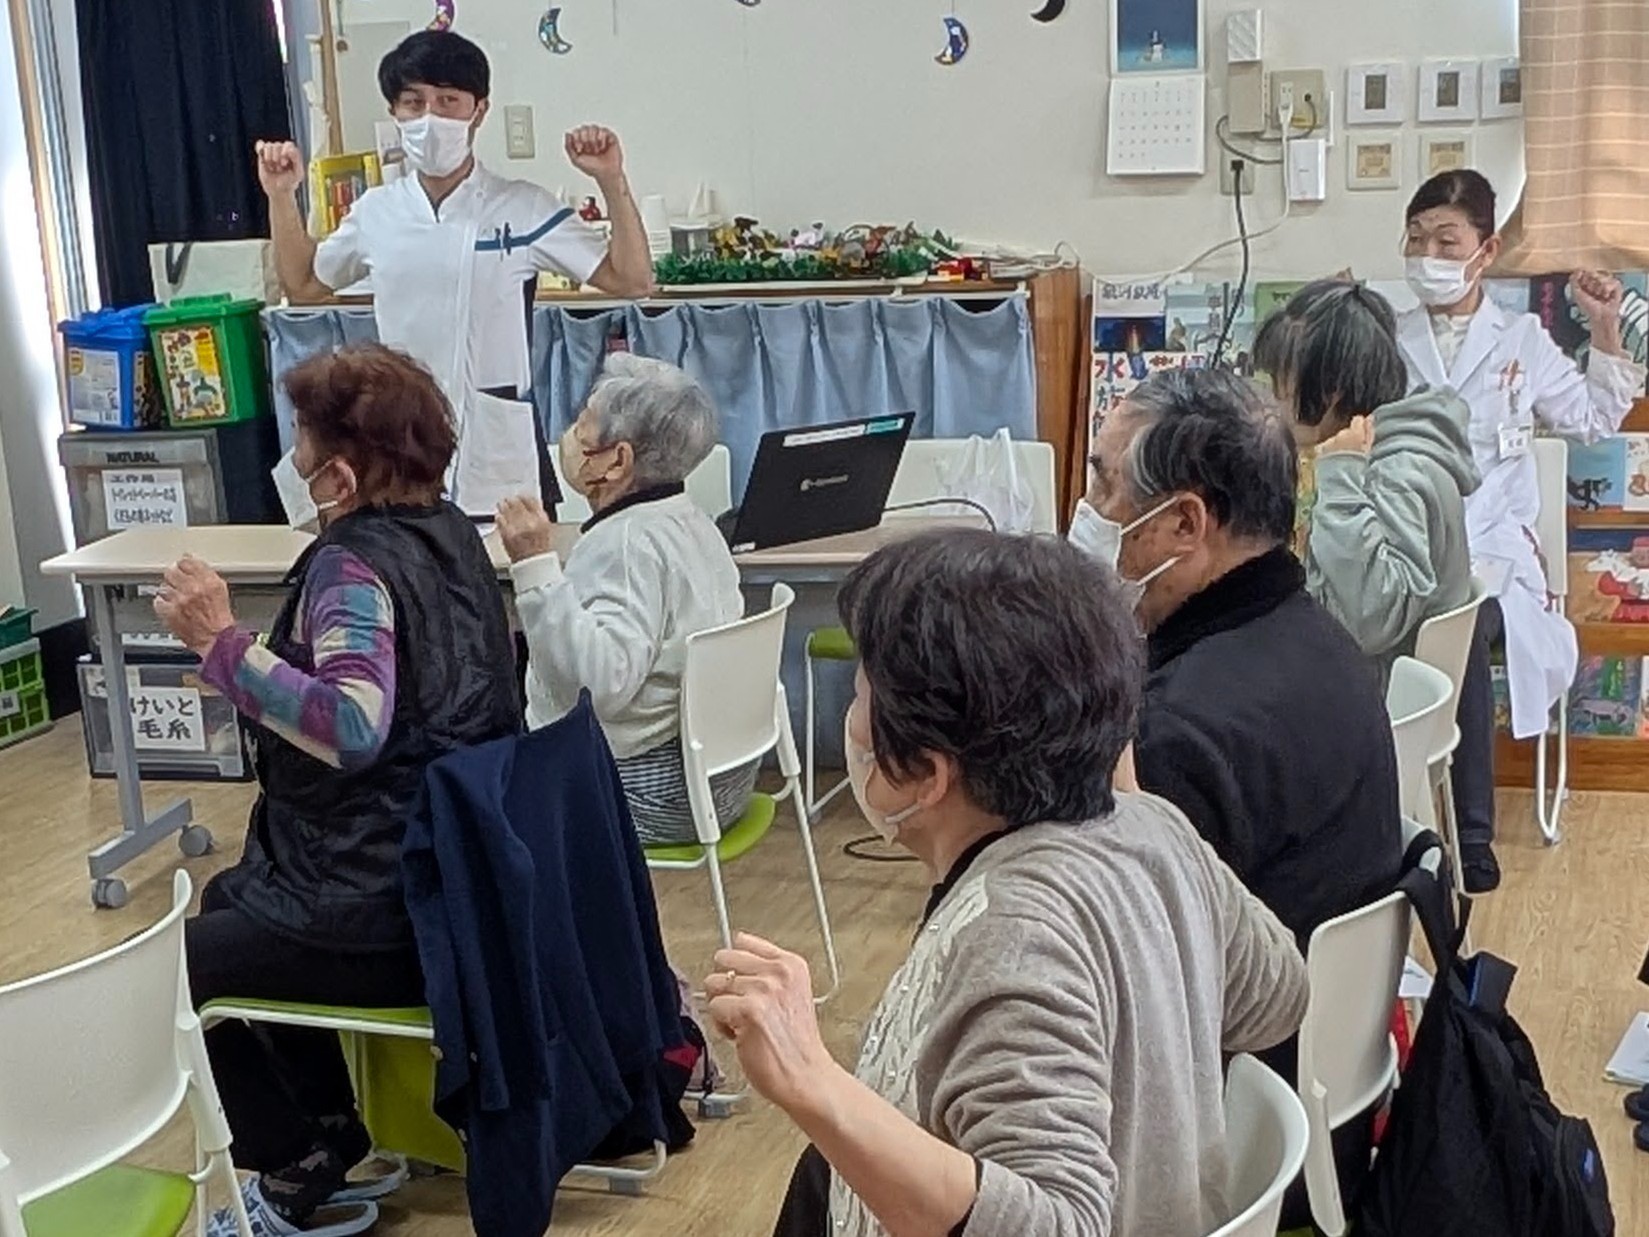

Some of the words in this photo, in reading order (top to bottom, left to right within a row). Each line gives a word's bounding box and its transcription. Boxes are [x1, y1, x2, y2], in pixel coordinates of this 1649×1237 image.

[106, 450, 160, 464] NATURAL
[130, 696, 195, 717] けいと
[137, 718, 192, 740] 毛糸
